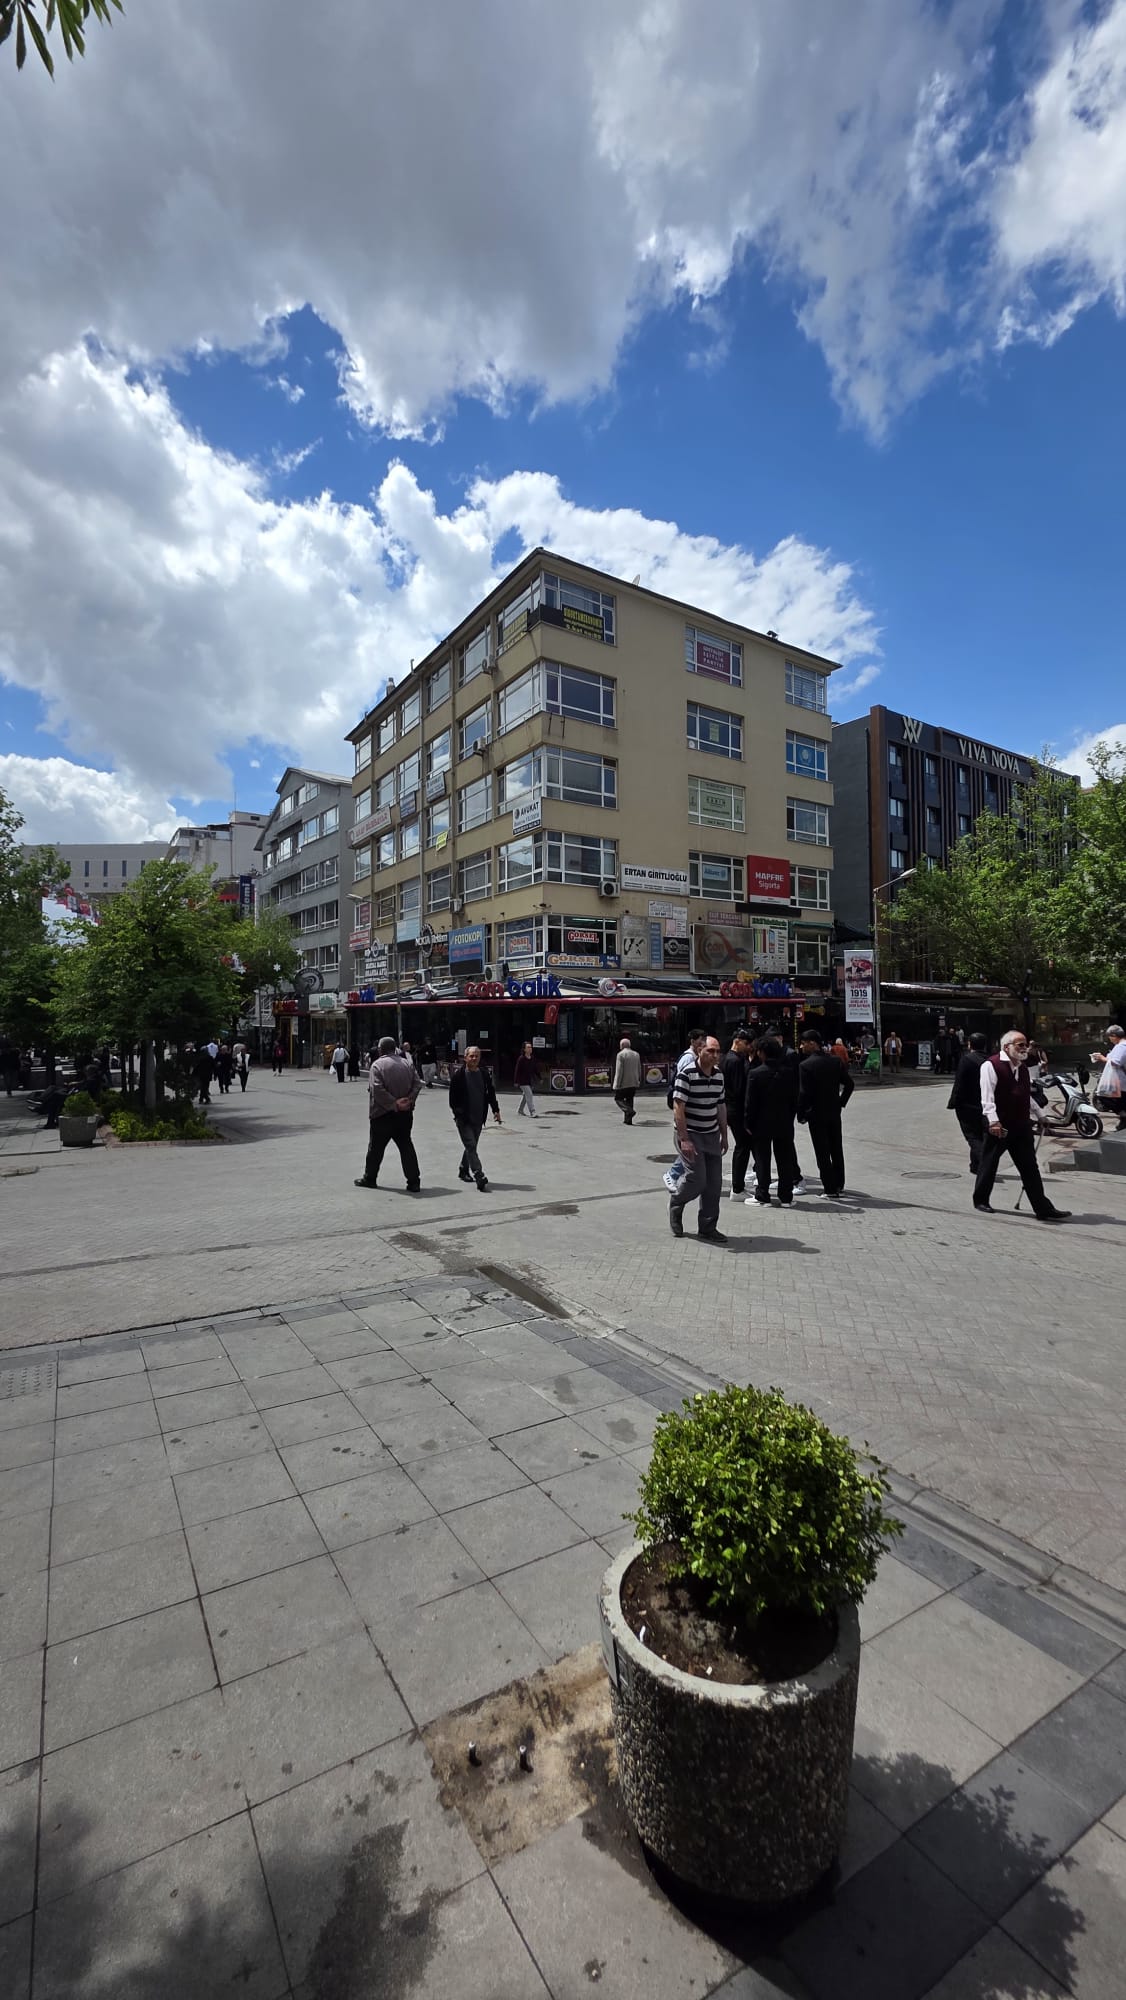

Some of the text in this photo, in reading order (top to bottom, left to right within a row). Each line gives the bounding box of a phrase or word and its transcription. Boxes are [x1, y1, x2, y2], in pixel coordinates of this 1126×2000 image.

[958, 738, 1020, 775] VIVA NOVA
[624, 867, 647, 878] ERTAN
[755, 871, 784, 882] MAPFRE
[758, 880, 780, 890] Sigorta
[567, 930, 600, 943] GÖRSEL
[547, 953, 604, 967] GÖRSEL
[464, 981, 505, 998] can
[720, 981, 753, 998] can
[850, 989, 868, 998] 1919
